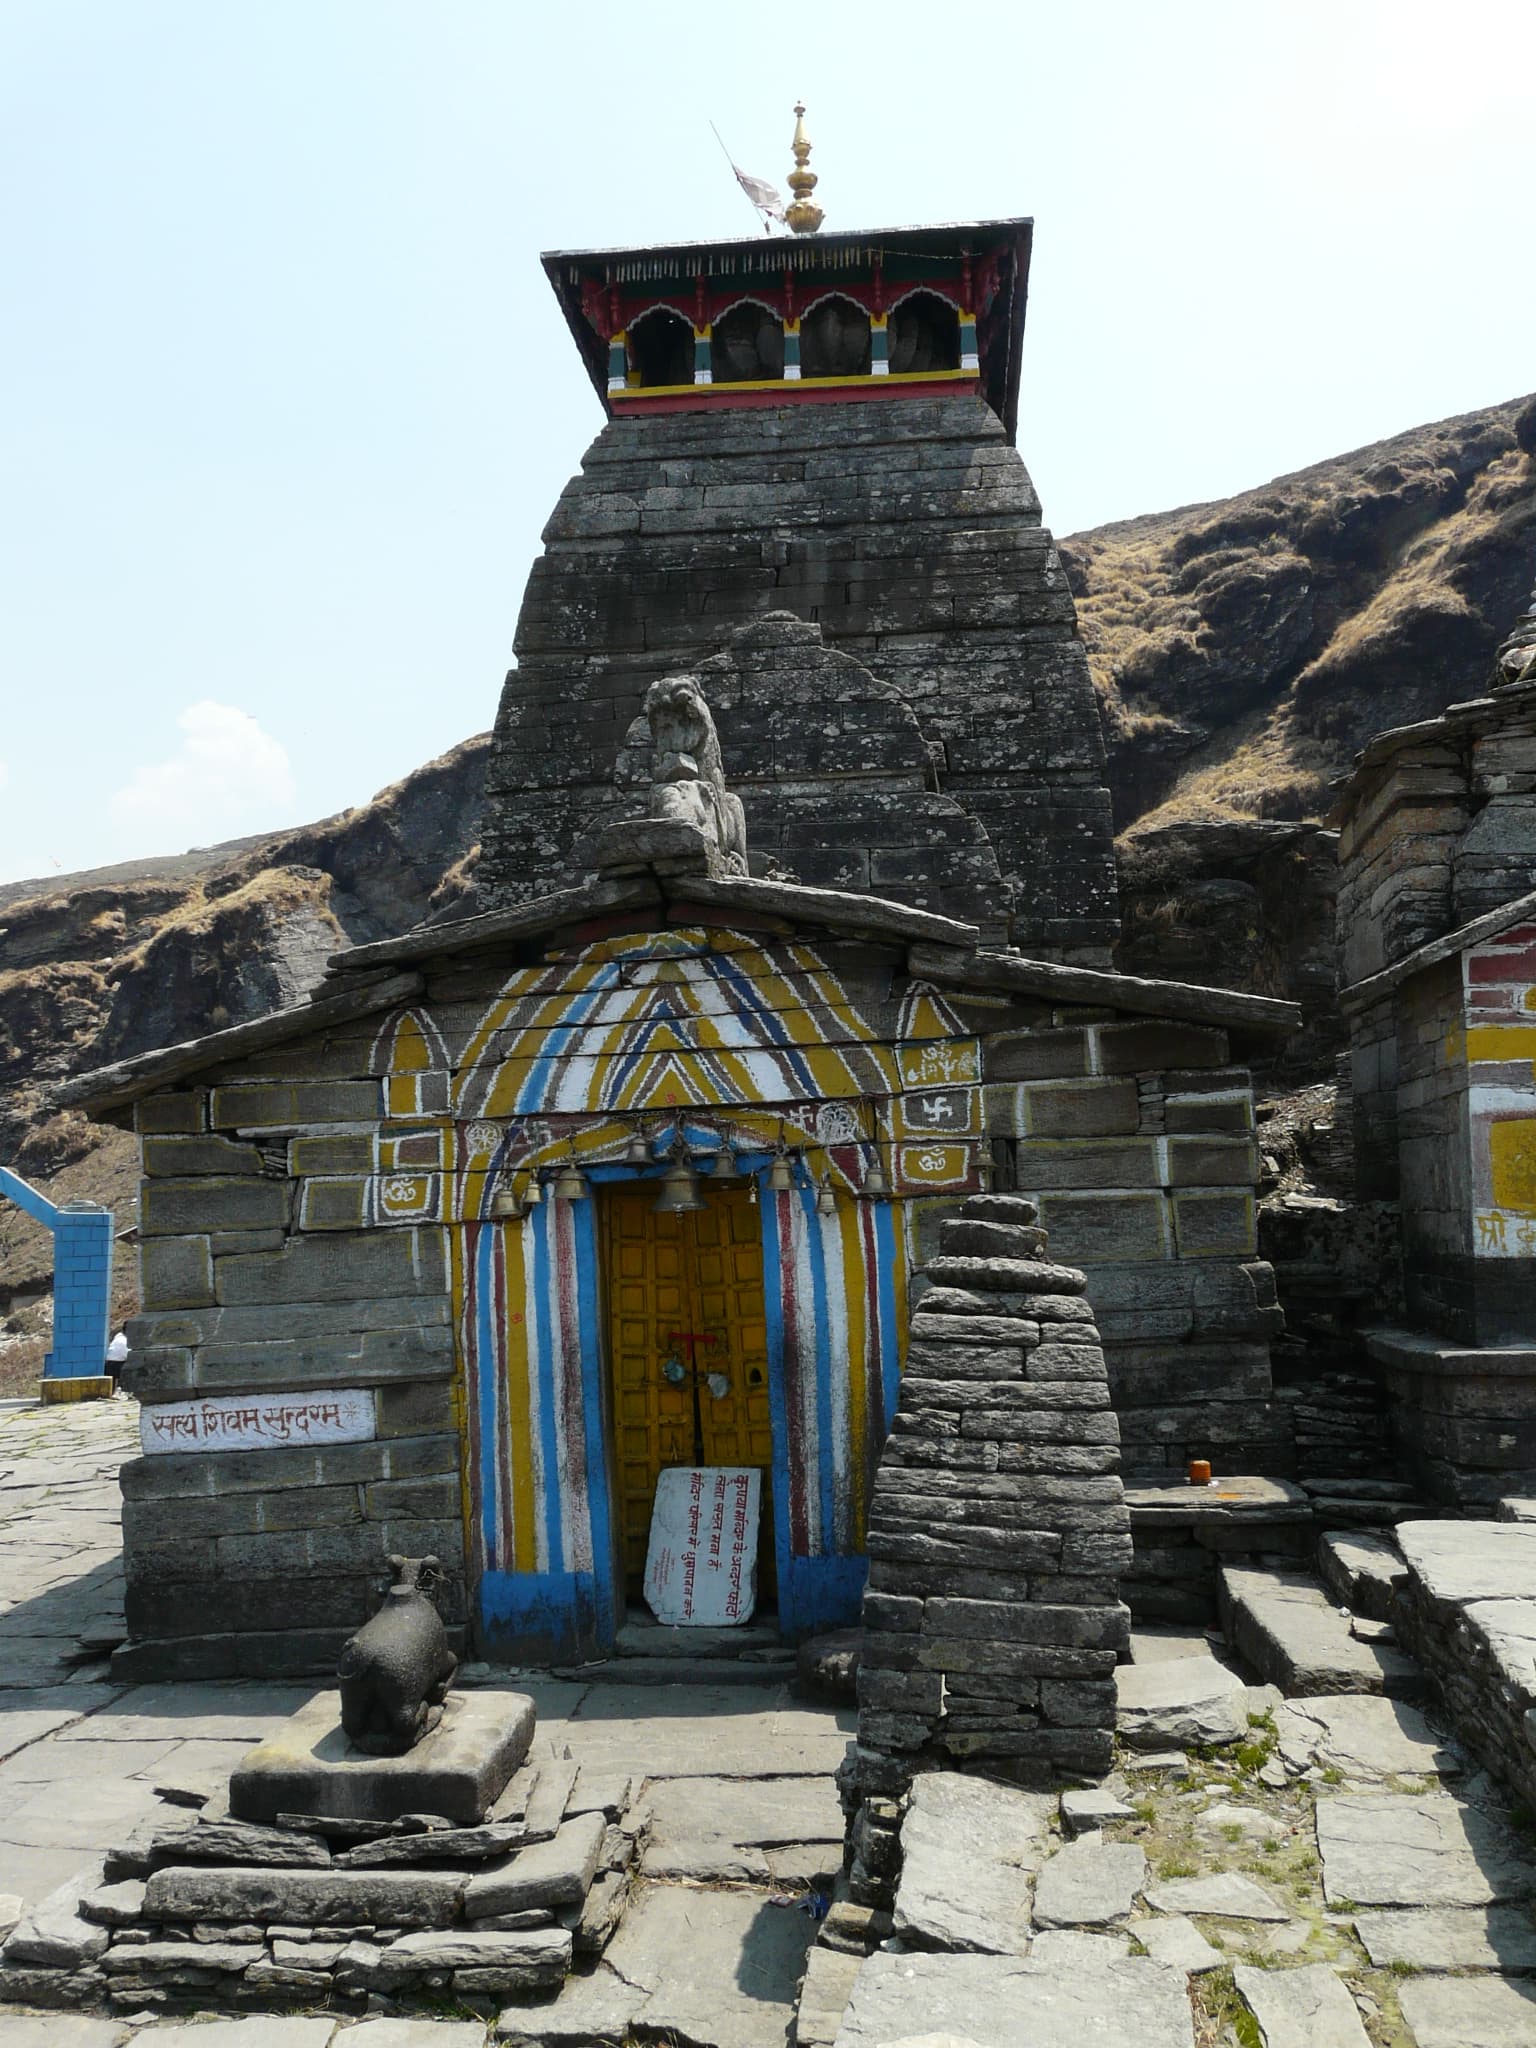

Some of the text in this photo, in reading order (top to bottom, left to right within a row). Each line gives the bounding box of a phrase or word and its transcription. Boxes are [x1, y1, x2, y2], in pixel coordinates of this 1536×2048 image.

[152, 1403, 344, 1440] सत्यं शिवम् सुन्दरम्
[733, 1543, 747, 1554] के
